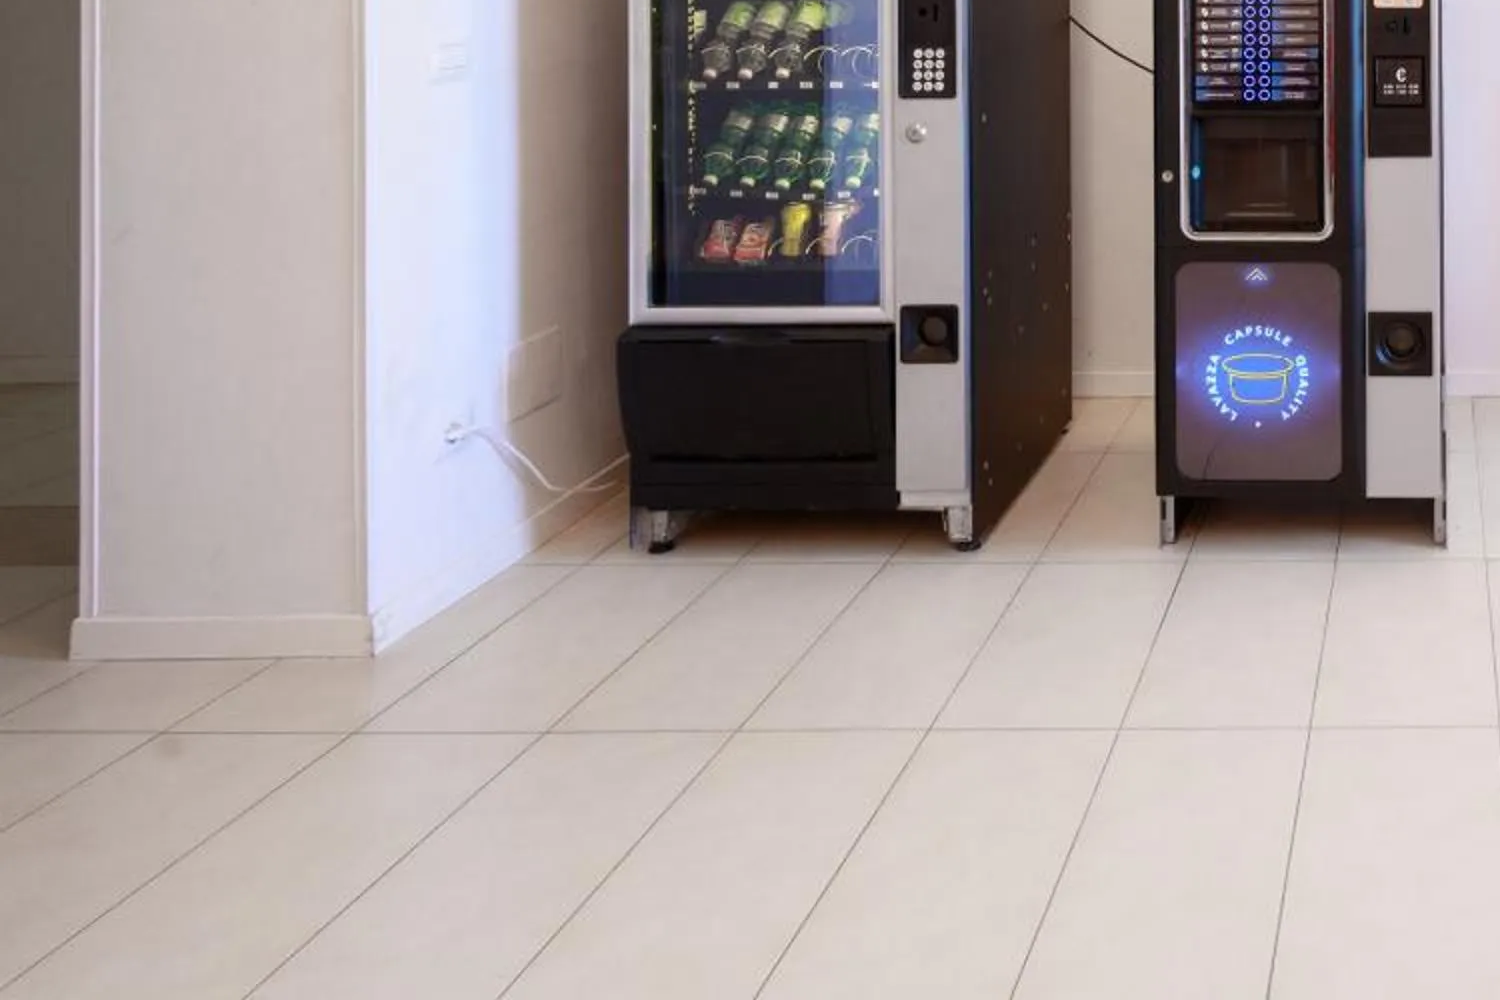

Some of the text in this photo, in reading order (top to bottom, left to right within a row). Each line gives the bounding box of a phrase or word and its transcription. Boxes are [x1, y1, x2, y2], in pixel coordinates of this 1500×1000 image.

[1206, 325, 1309, 421] LAVAZZA CAPSULE QUALITY
